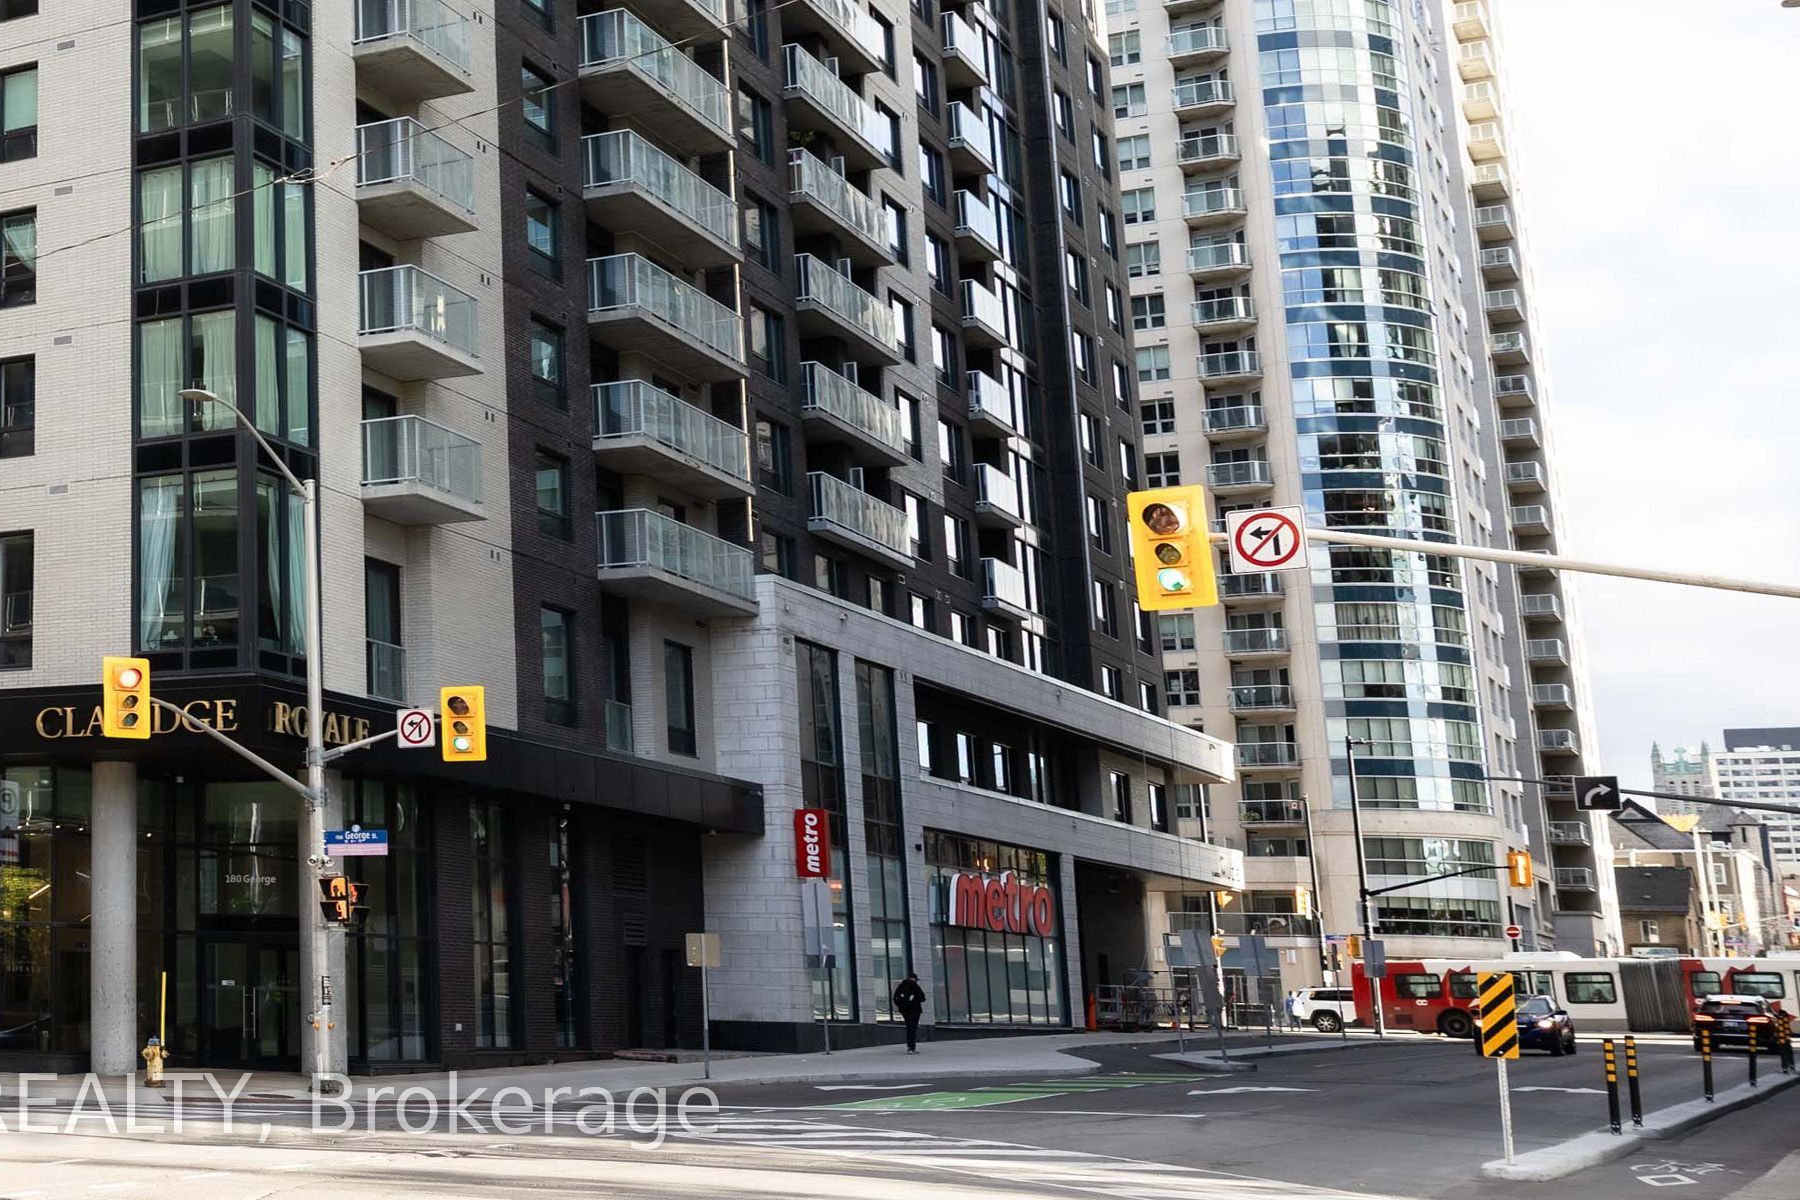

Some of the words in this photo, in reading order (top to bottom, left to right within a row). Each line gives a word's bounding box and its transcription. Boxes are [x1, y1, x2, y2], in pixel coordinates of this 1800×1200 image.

[36, 699, 238, 738] CLADGE
[273, 701, 371, 750] ROALE
[344, 831, 370, 841] George
[803, 813, 820, 873] metro
[225, 874, 241, 883] 180
[243, 874, 277, 886] George
[949, 871, 1052, 936] metro
